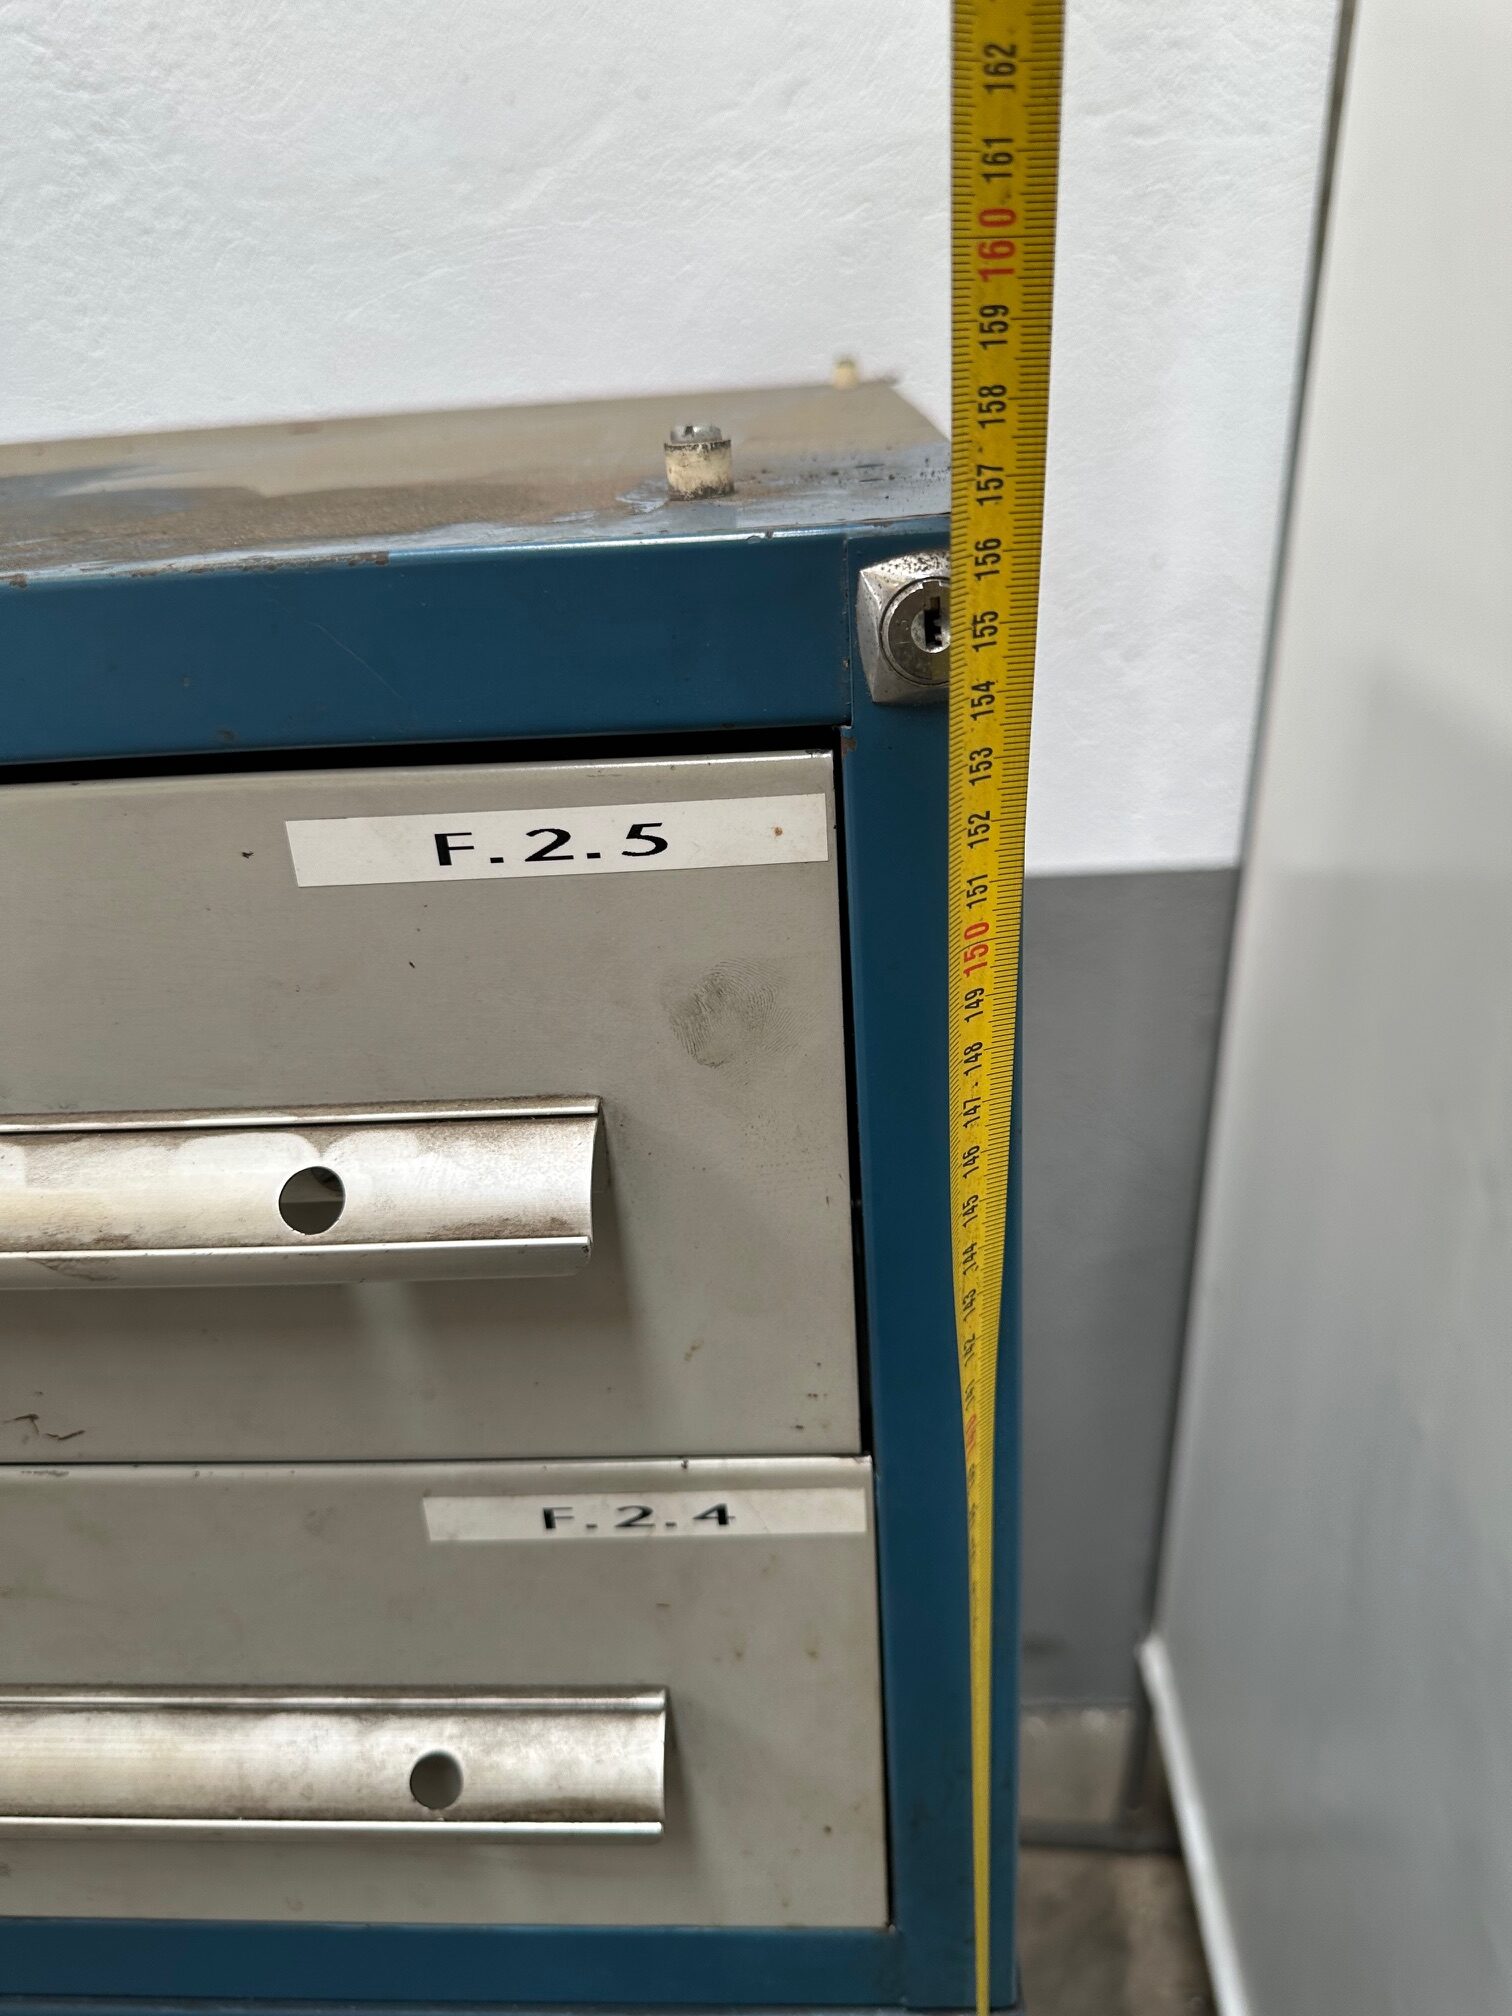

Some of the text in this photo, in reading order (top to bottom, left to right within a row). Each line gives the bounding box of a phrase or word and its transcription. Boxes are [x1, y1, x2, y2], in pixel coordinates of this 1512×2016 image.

[983, 43, 1017, 94] 162
[981, 137, 1014, 183] 161
[977, 207, 1017, 282] 160
[979, 304, 1010, 350] 159
[978, 384, 1007, 429] 158
[976, 464, 1004, 506] 157
[975, 538, 1001, 581] 156
[971, 610, 999, 652] 155
[971, 680, 996, 721] 154
[968, 747, 993, 786] 153
[967, 810, 990, 849] 152
[966, 874, 988, 909] 151
[963, 921, 990, 978] 150
[964, 987, 984, 1023] 149
[963, 1041, 983, 1076] 148
[963, 1096, 982, 1128] 147
[963, 1145, 980, 1179] 146
[962, 1194, 979, 1228] 145
